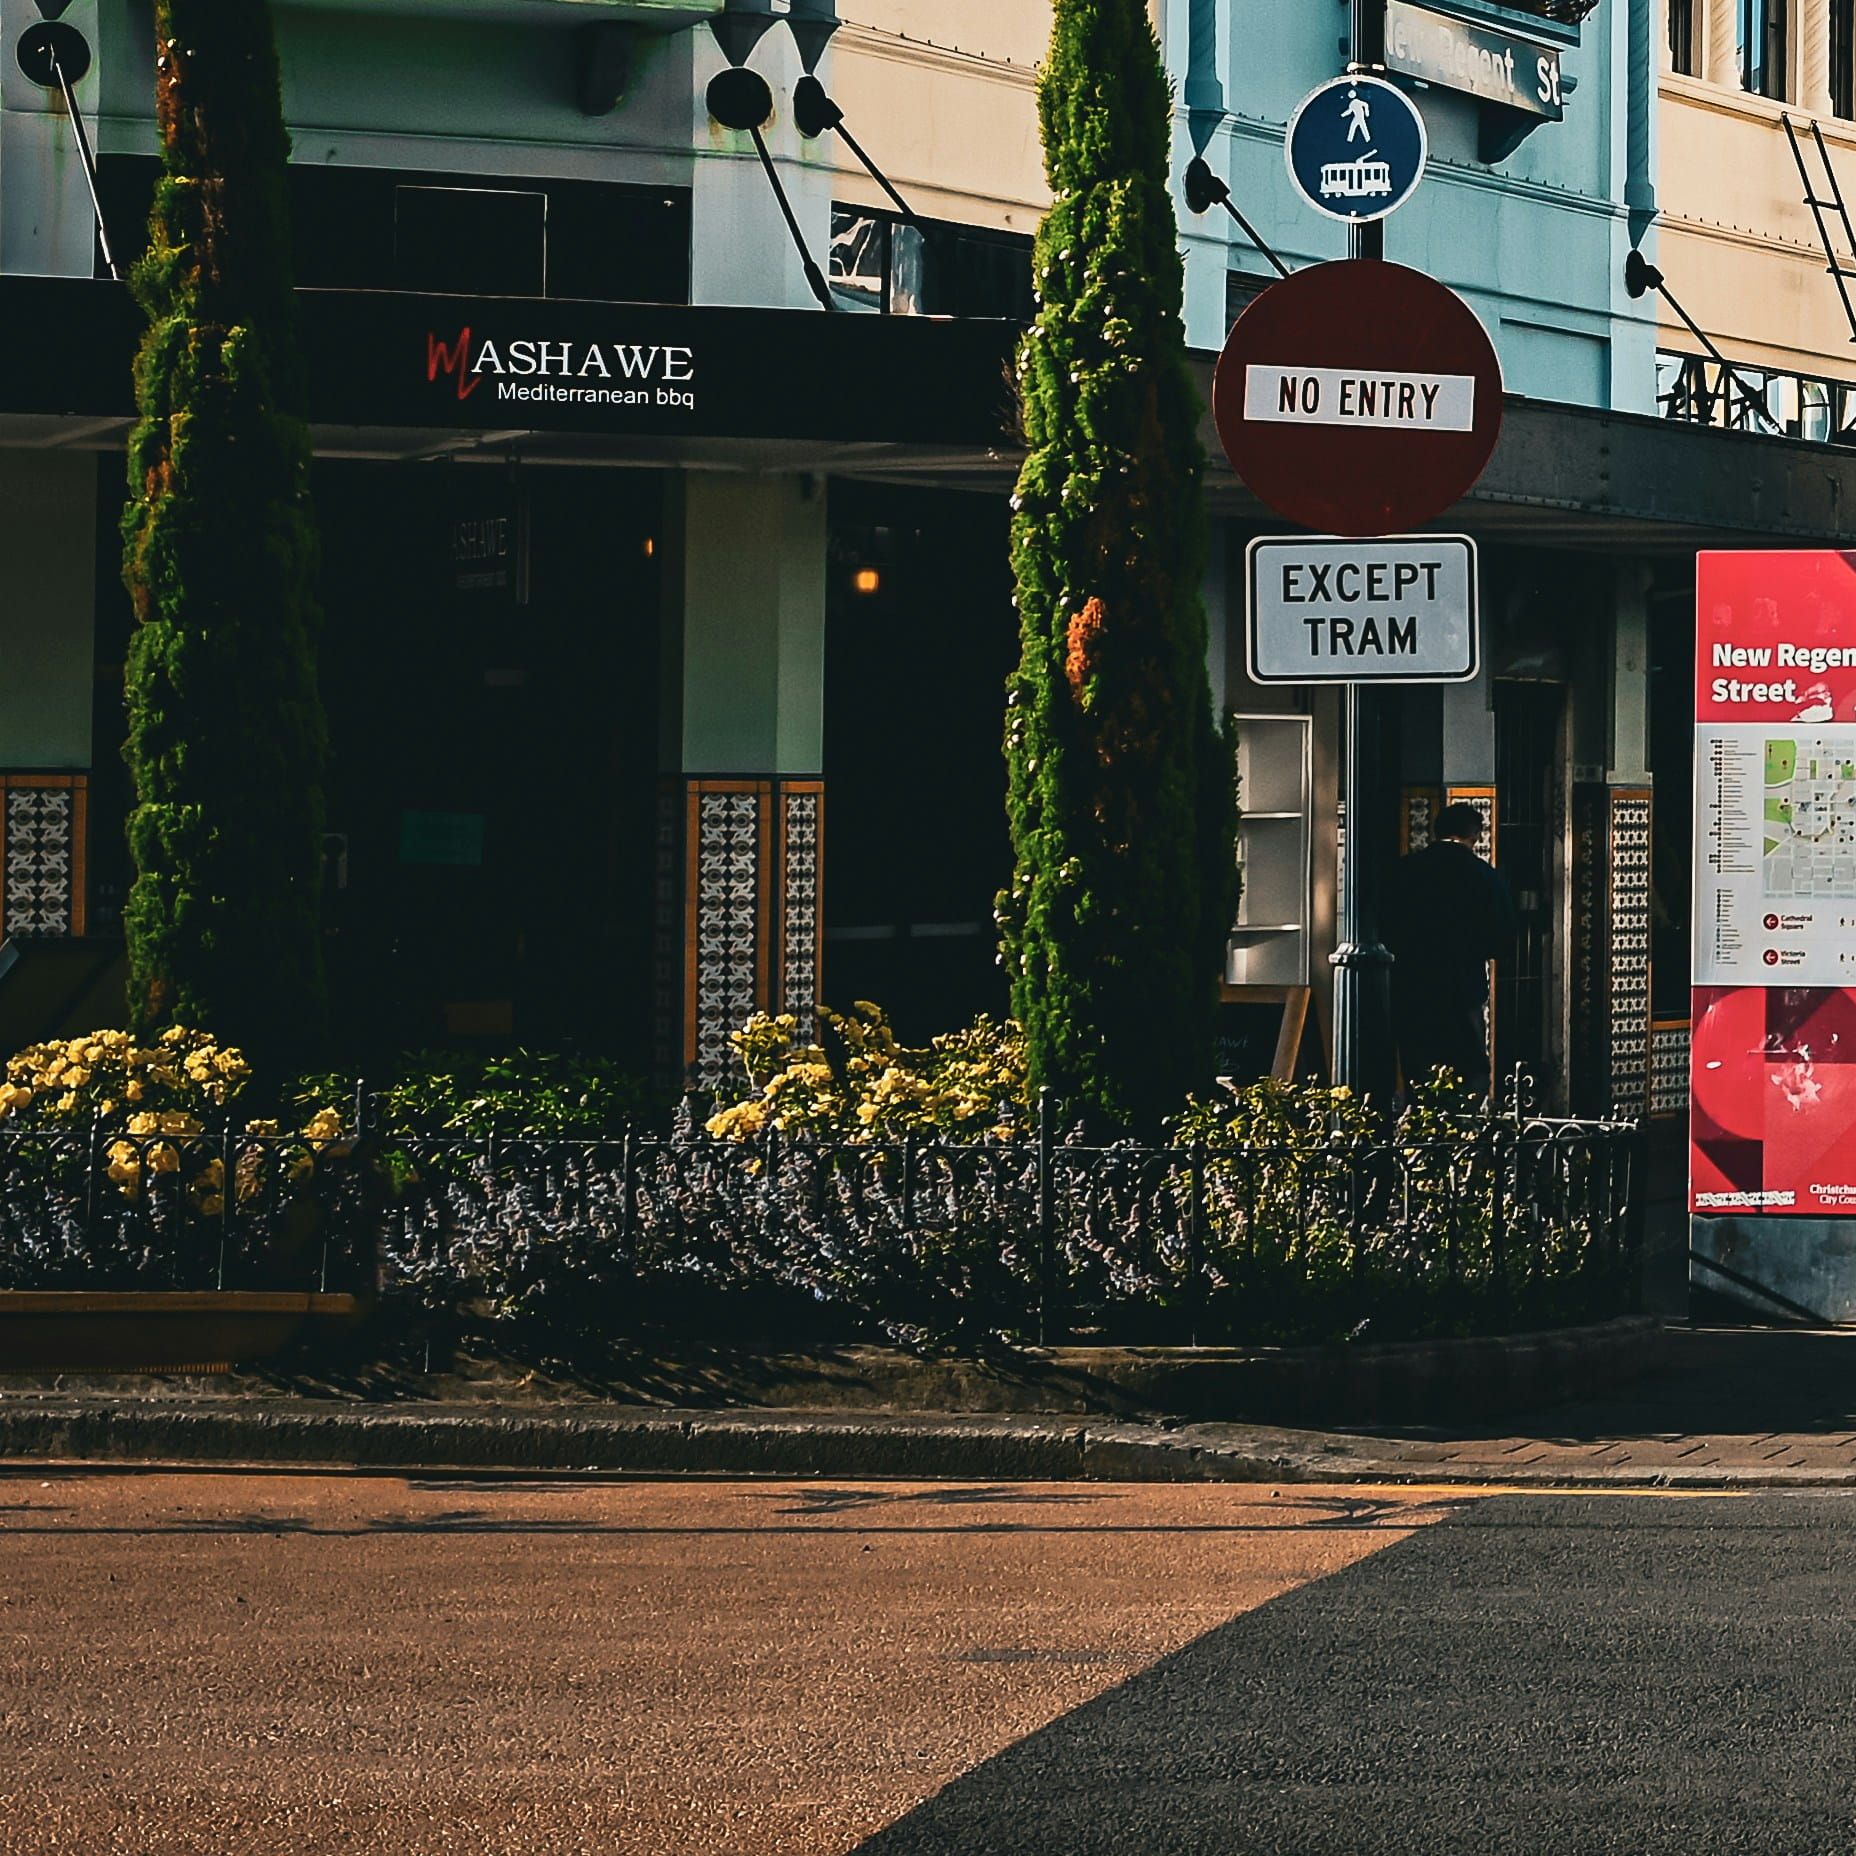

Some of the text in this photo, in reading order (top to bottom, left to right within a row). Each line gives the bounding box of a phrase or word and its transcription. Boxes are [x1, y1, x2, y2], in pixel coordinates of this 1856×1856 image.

[1537, 55, 1561, 106] St
[427, 326, 695, 400] MASHAWE
[498, 382, 695, 410] Mediterranean bbq
[1278, 375, 1441, 421] NO ENTRY
[1281, 562, 1442, 603] EXCEPT
[1303, 616, 1417, 657] TRAM
[1712, 643, 1772, 668] New
[1711, 678, 1797, 703] Street
[1819, 1194, 1838, 1206] City
